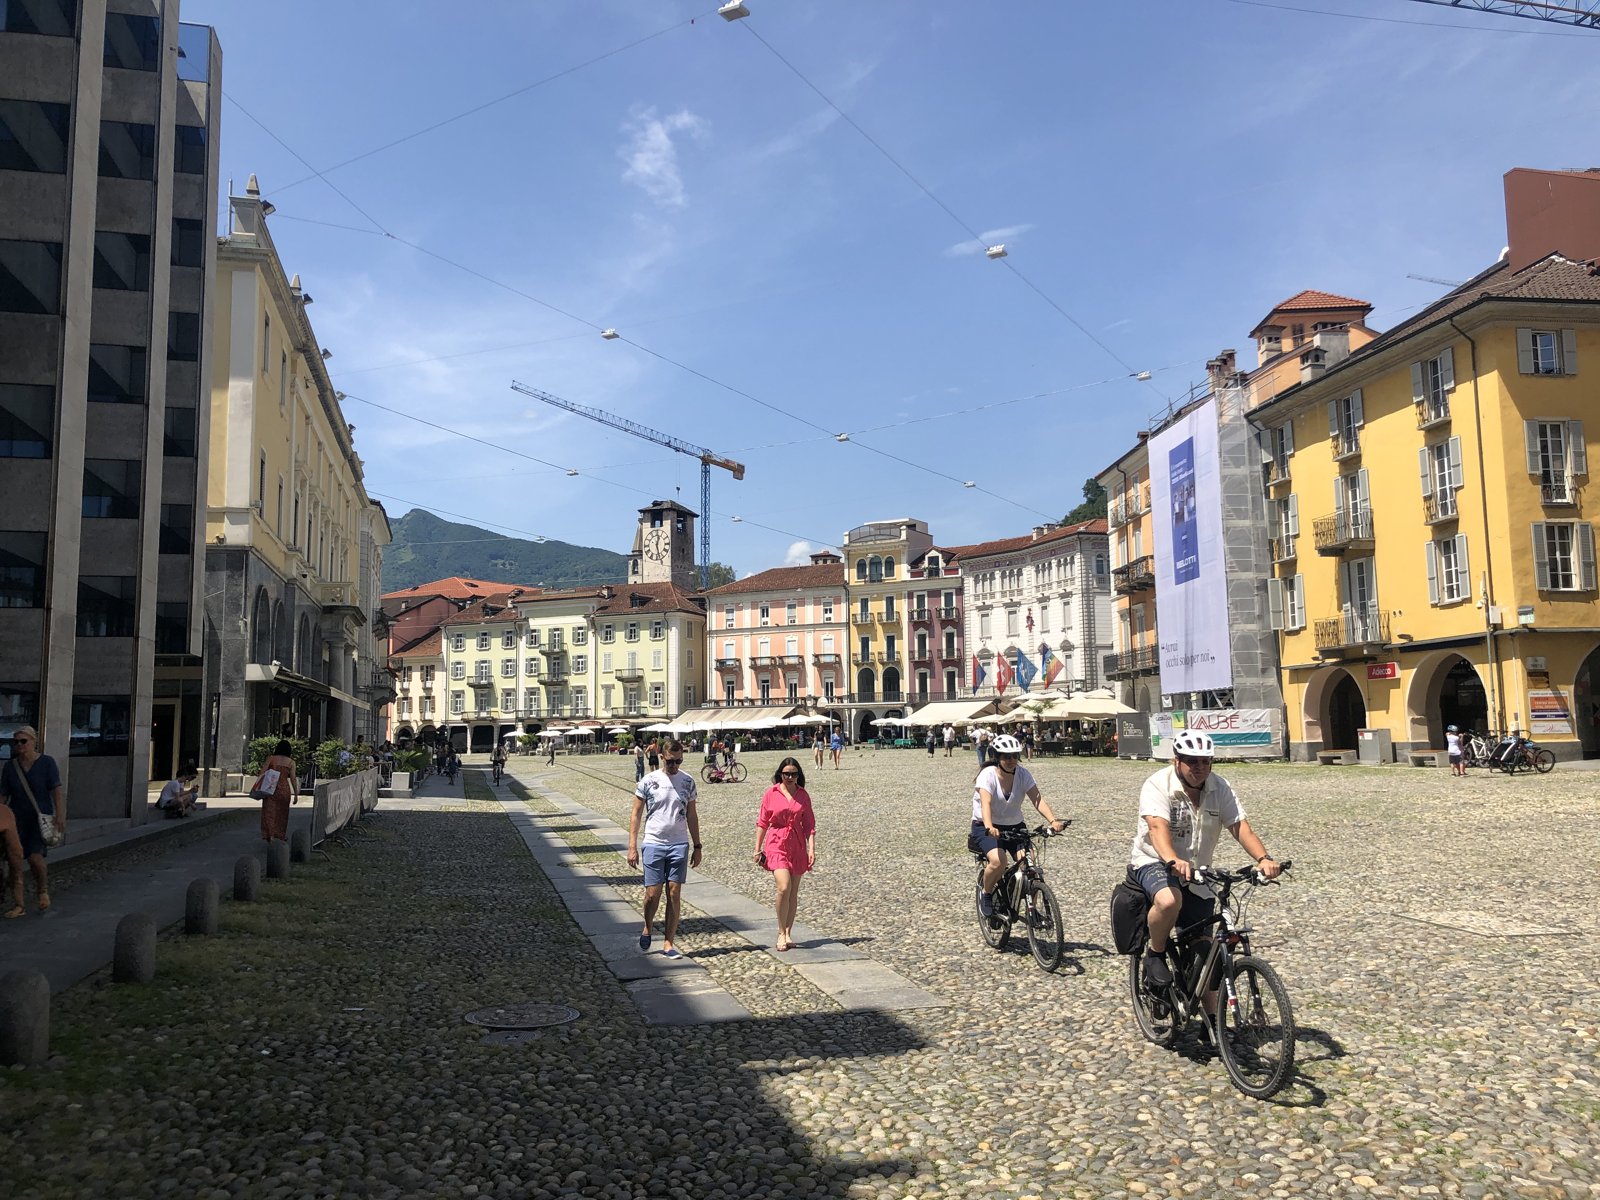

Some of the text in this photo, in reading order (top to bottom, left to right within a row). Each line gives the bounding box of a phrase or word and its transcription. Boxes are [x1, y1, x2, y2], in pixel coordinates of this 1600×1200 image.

[1176, 555, 1196, 569] BELOTTI
[1166, 655, 1178, 668] occhi
[1179, 653, 1190, 666] solo
[1190, 654, 1199, 667] per
[1372, 667, 1391, 675] Adecco
